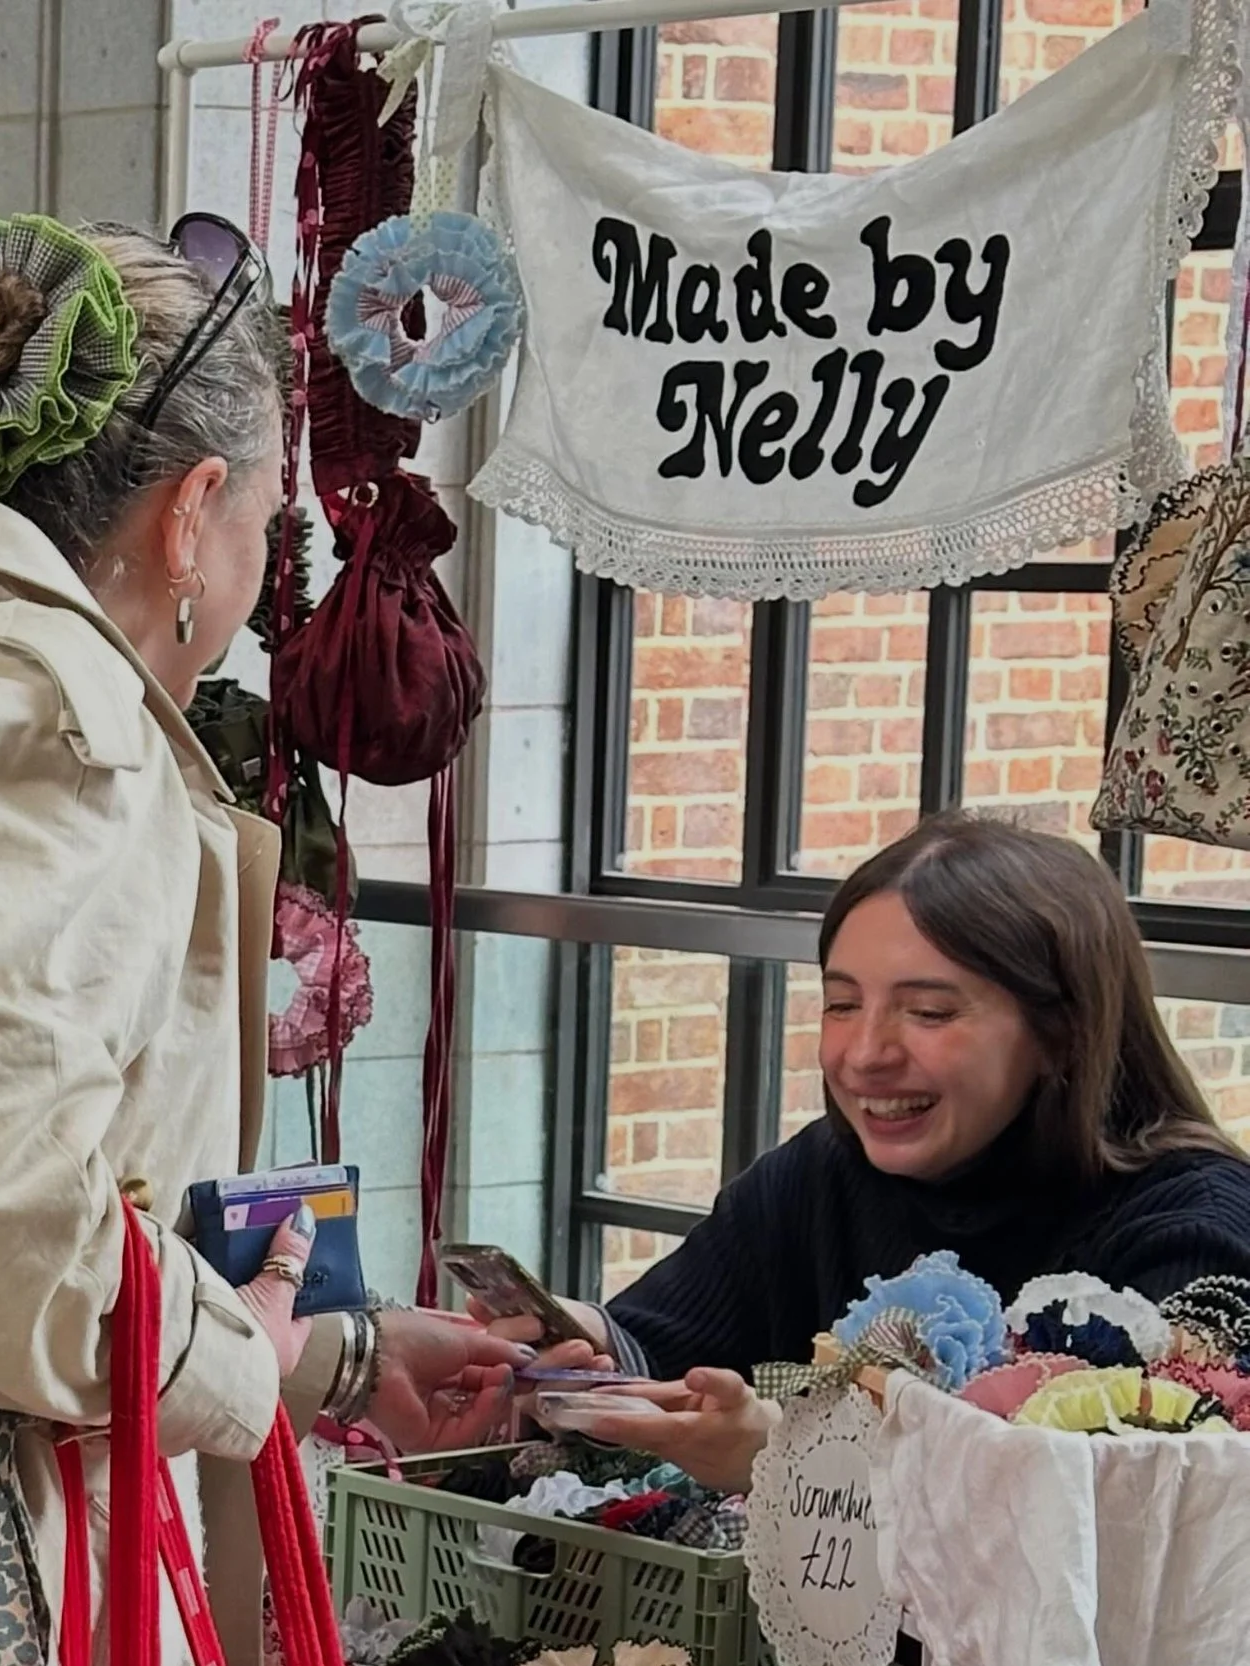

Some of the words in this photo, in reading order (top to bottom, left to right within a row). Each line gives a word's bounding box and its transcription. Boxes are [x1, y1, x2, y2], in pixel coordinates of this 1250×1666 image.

[593, 215, 837, 344] Made
[860, 215, 1010, 371] by
[656, 347, 950, 508] Nelly
[790, 1474, 877, 1530] Scrunchie
[800, 1528, 857, 1591] £22
